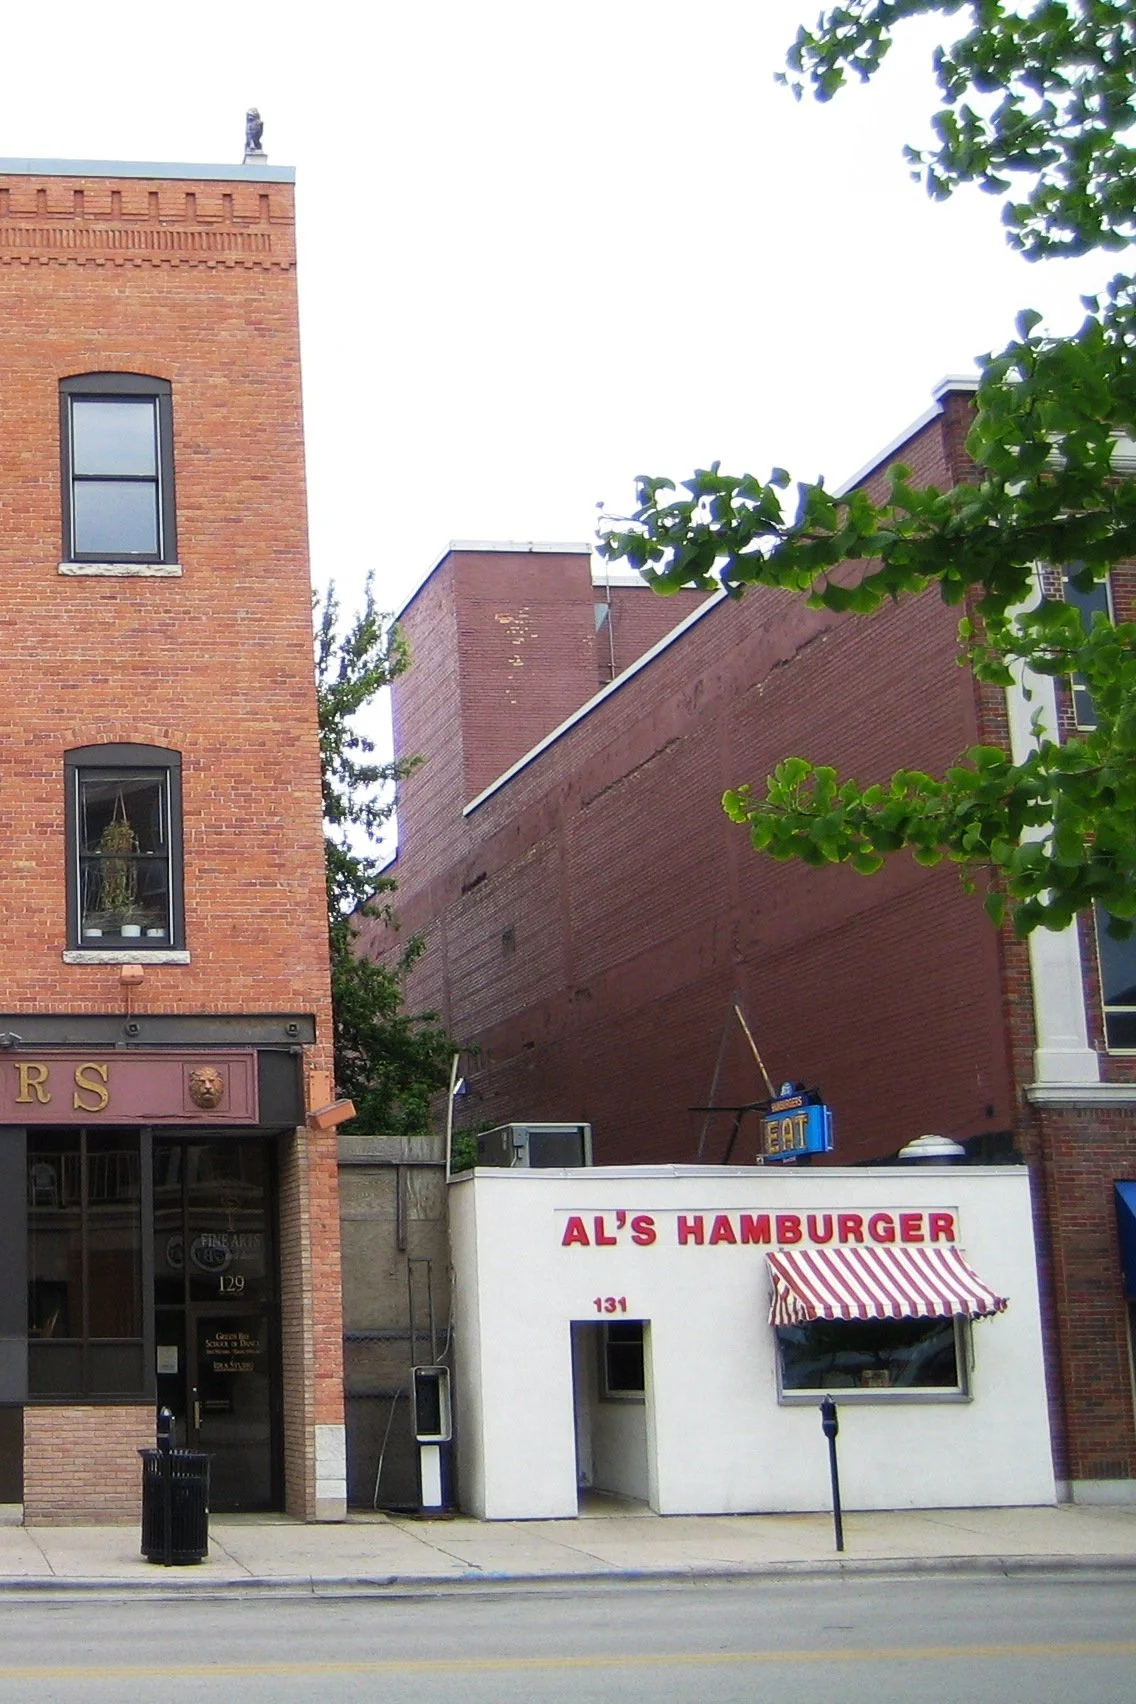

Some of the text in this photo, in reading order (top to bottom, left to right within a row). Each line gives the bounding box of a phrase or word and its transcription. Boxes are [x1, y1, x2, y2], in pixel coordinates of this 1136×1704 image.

[767, 1114, 808, 1154] EAT
[561, 1209, 955, 1246] AL'S HAMBURGER
[201, 1233, 261, 1247] FINE ARTS
[219, 1275, 245, 1292] 129
[593, 1297, 628, 1313] 131
